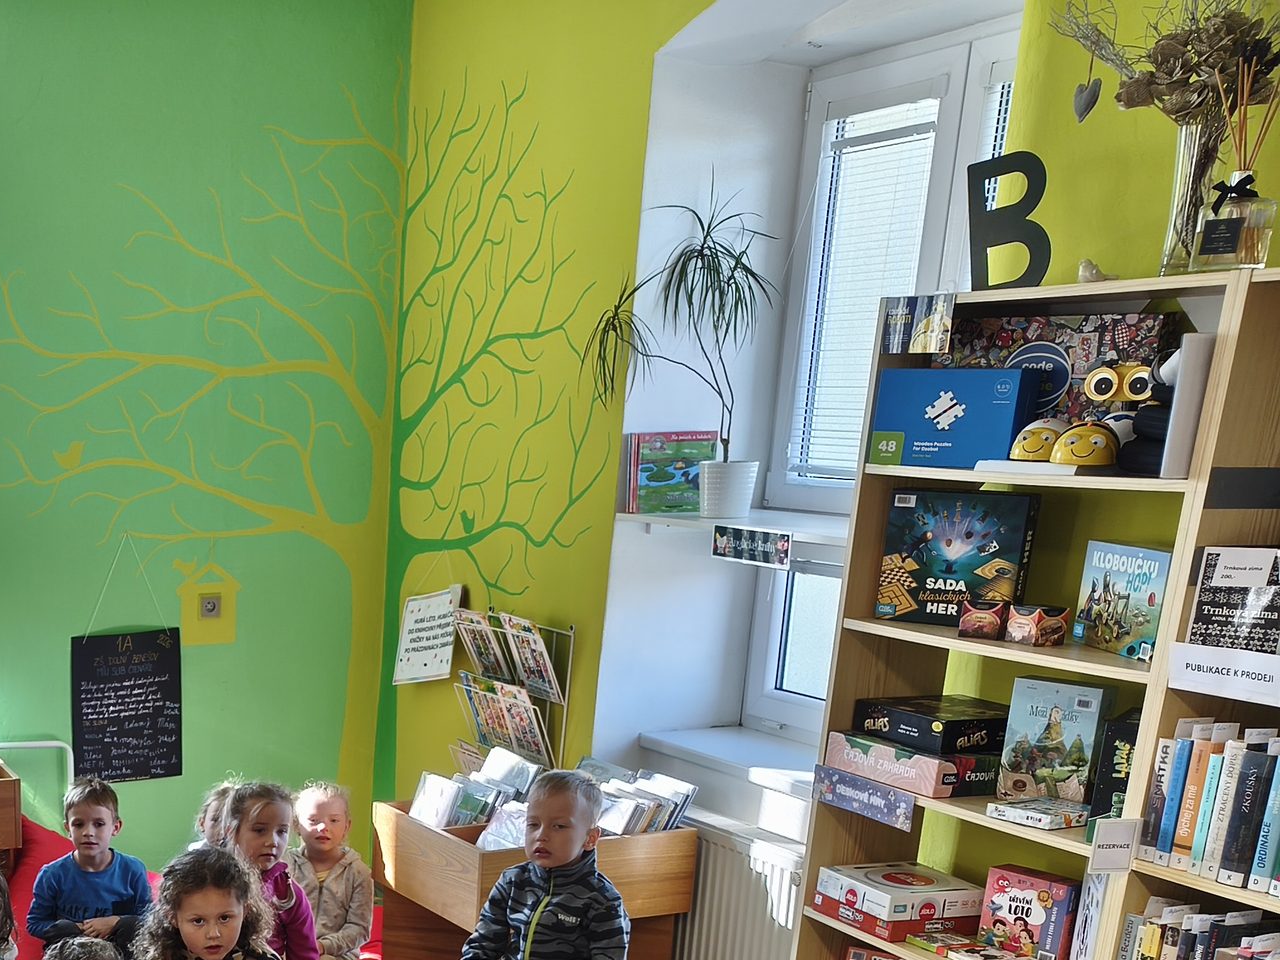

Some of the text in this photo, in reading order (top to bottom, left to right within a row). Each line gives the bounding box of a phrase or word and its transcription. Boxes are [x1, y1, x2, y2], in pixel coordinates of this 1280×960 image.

[967, 151, 1051, 291] B
[878, 440, 896, 452] 48
[1092, 550, 1160, 578] KLOBOUČKU
[925, 577, 967, 592] SADA
[918, 590, 972, 603] klasických
[925, 602, 958, 616] HER
[1185, 662, 1274, 683] PUBLIKACE K PRODEJI
[844, 745, 916, 779] ČAJOVÁ ZAHRADA
[965, 769, 996, 783] ČAJOVÁ
[1152, 744, 1170, 809] SMRTKA
[1241, 765, 1258, 814] ZKOUŠKY
[1097, 842, 1131, 850] REZERVACE
[1257, 821, 1271, 869] ORDINACE
[1008, 904, 1032, 918] LOTO
